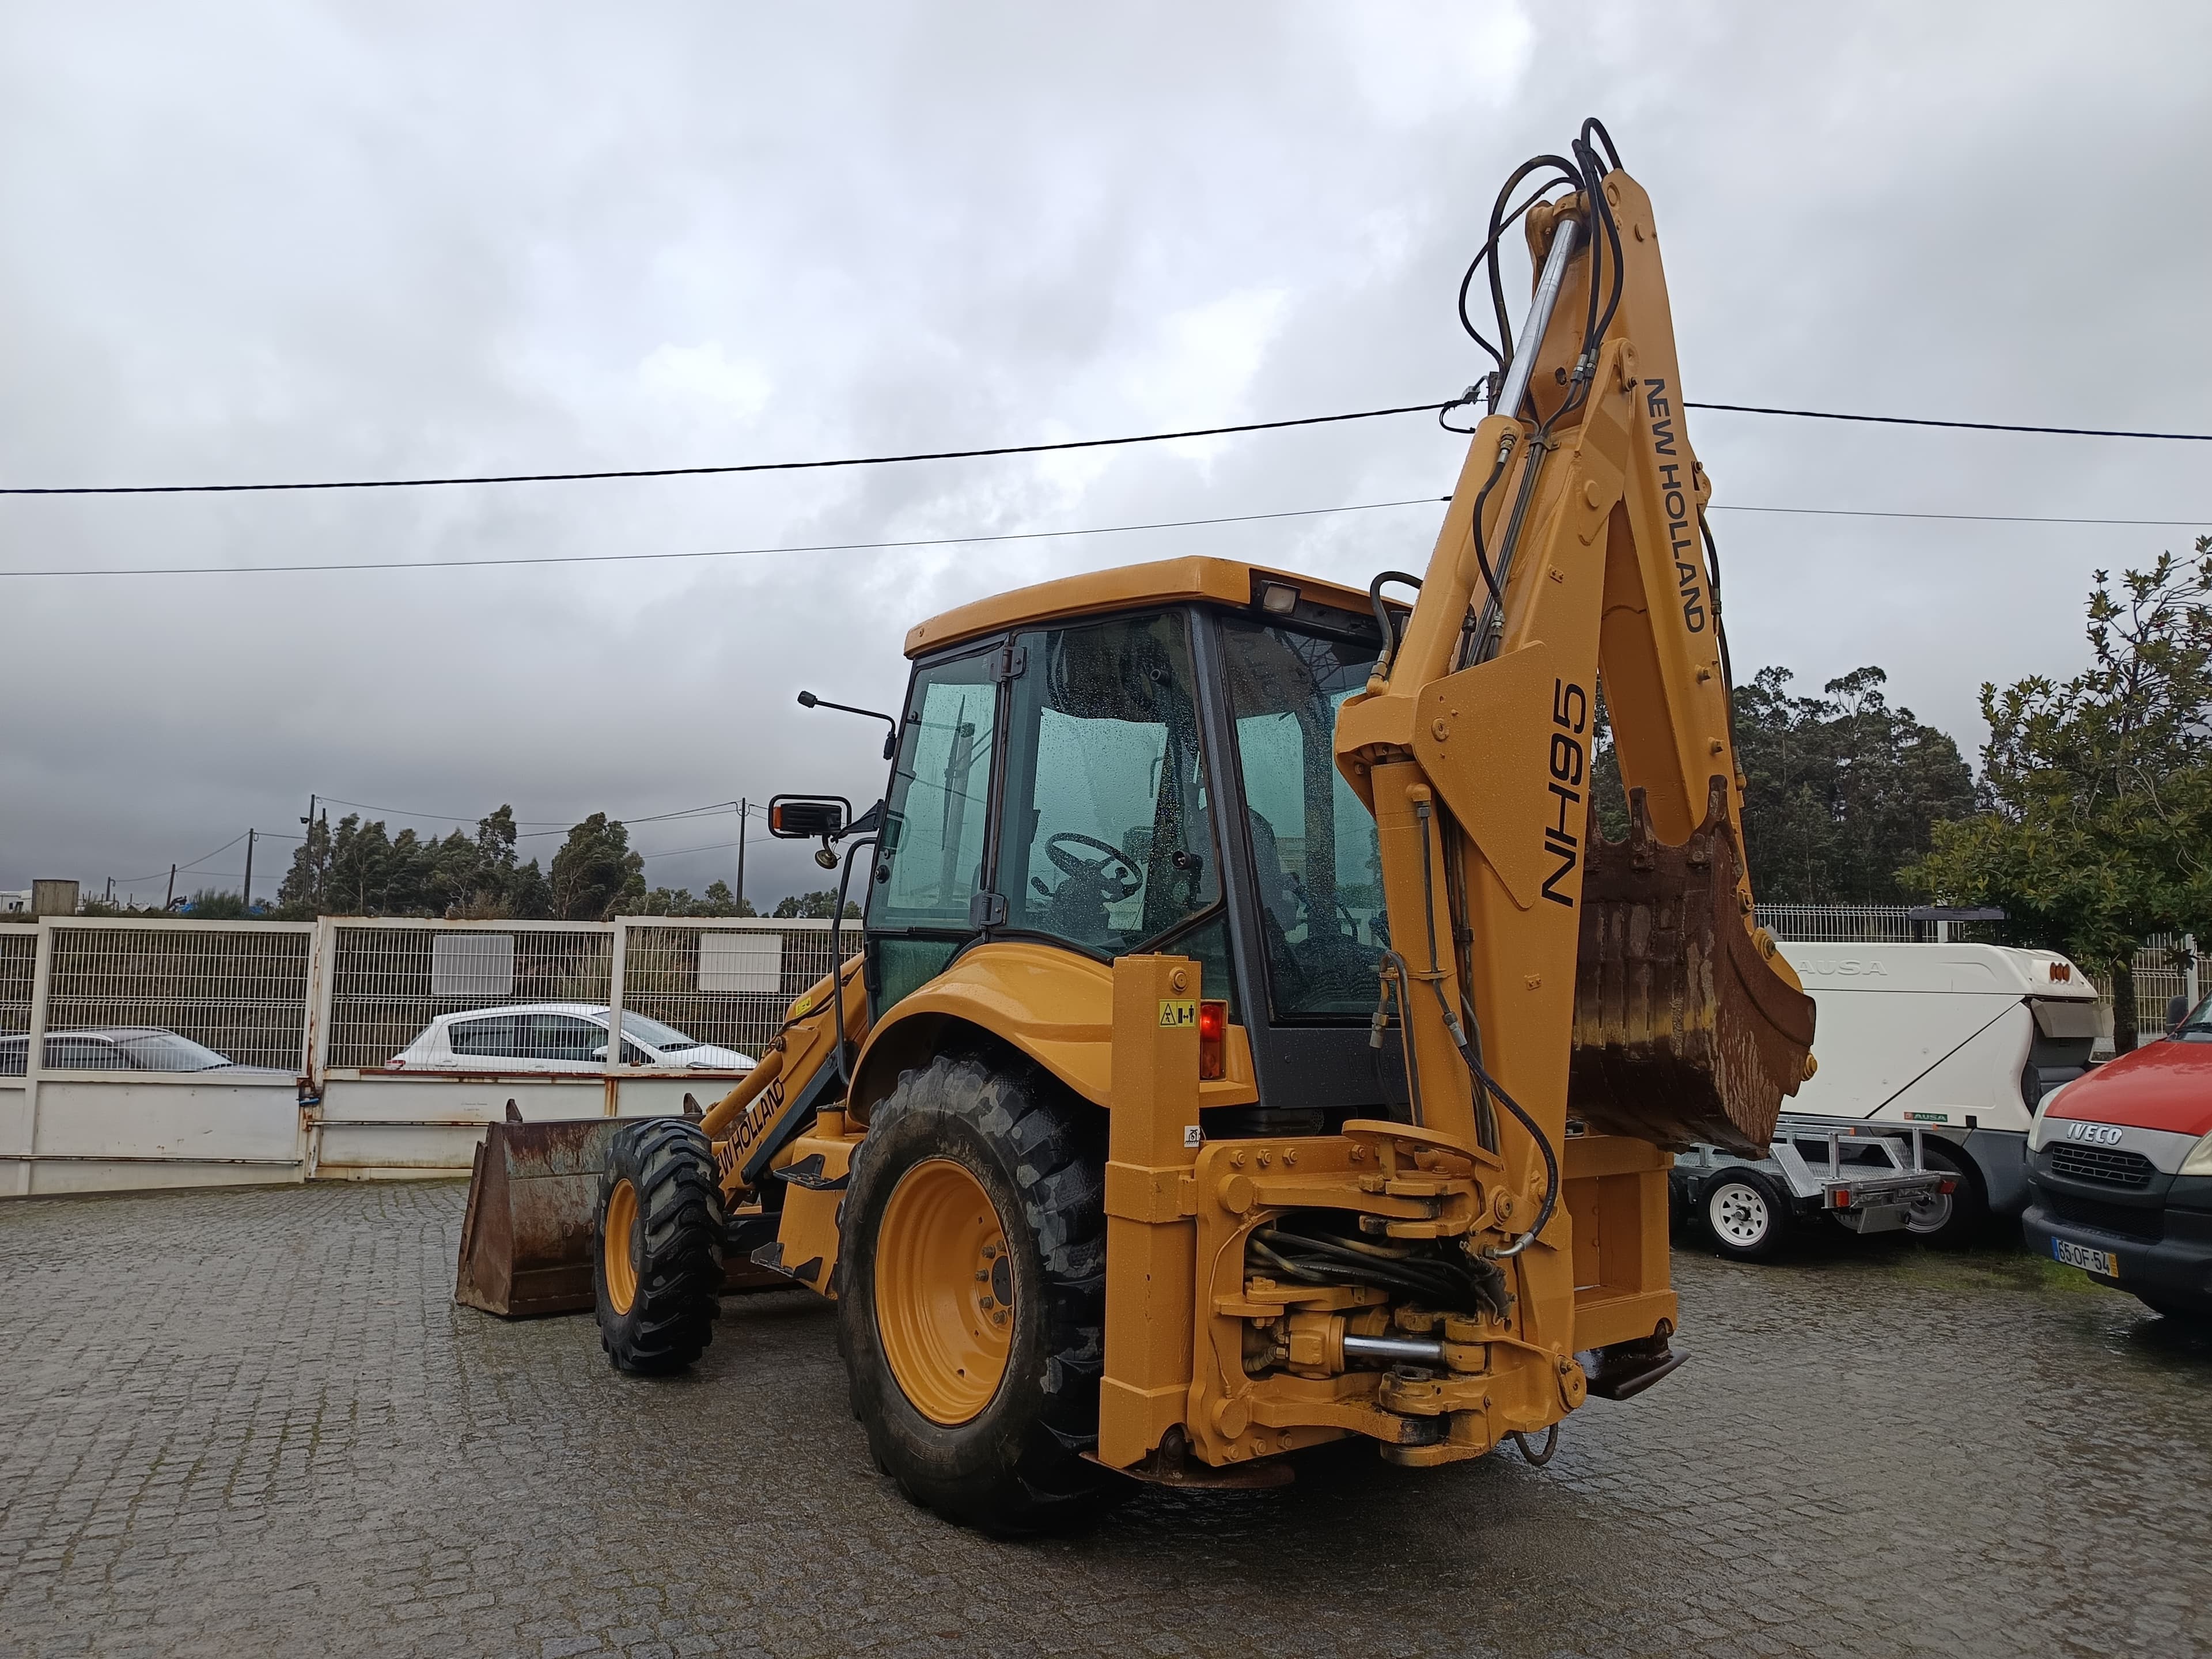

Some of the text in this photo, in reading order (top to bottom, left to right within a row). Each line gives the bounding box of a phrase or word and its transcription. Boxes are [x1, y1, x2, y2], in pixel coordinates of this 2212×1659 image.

[1644, 378, 1705, 633] NEW HOLLAND
[1541, 677, 1586, 908] NH95
[1797, 959, 1888, 976] AUSA
[731, 1076, 785, 1162] HOLLAND
[1914, 1113, 1947, 1122] AUSA
[2066, 1122, 2123, 1146] IVECO
